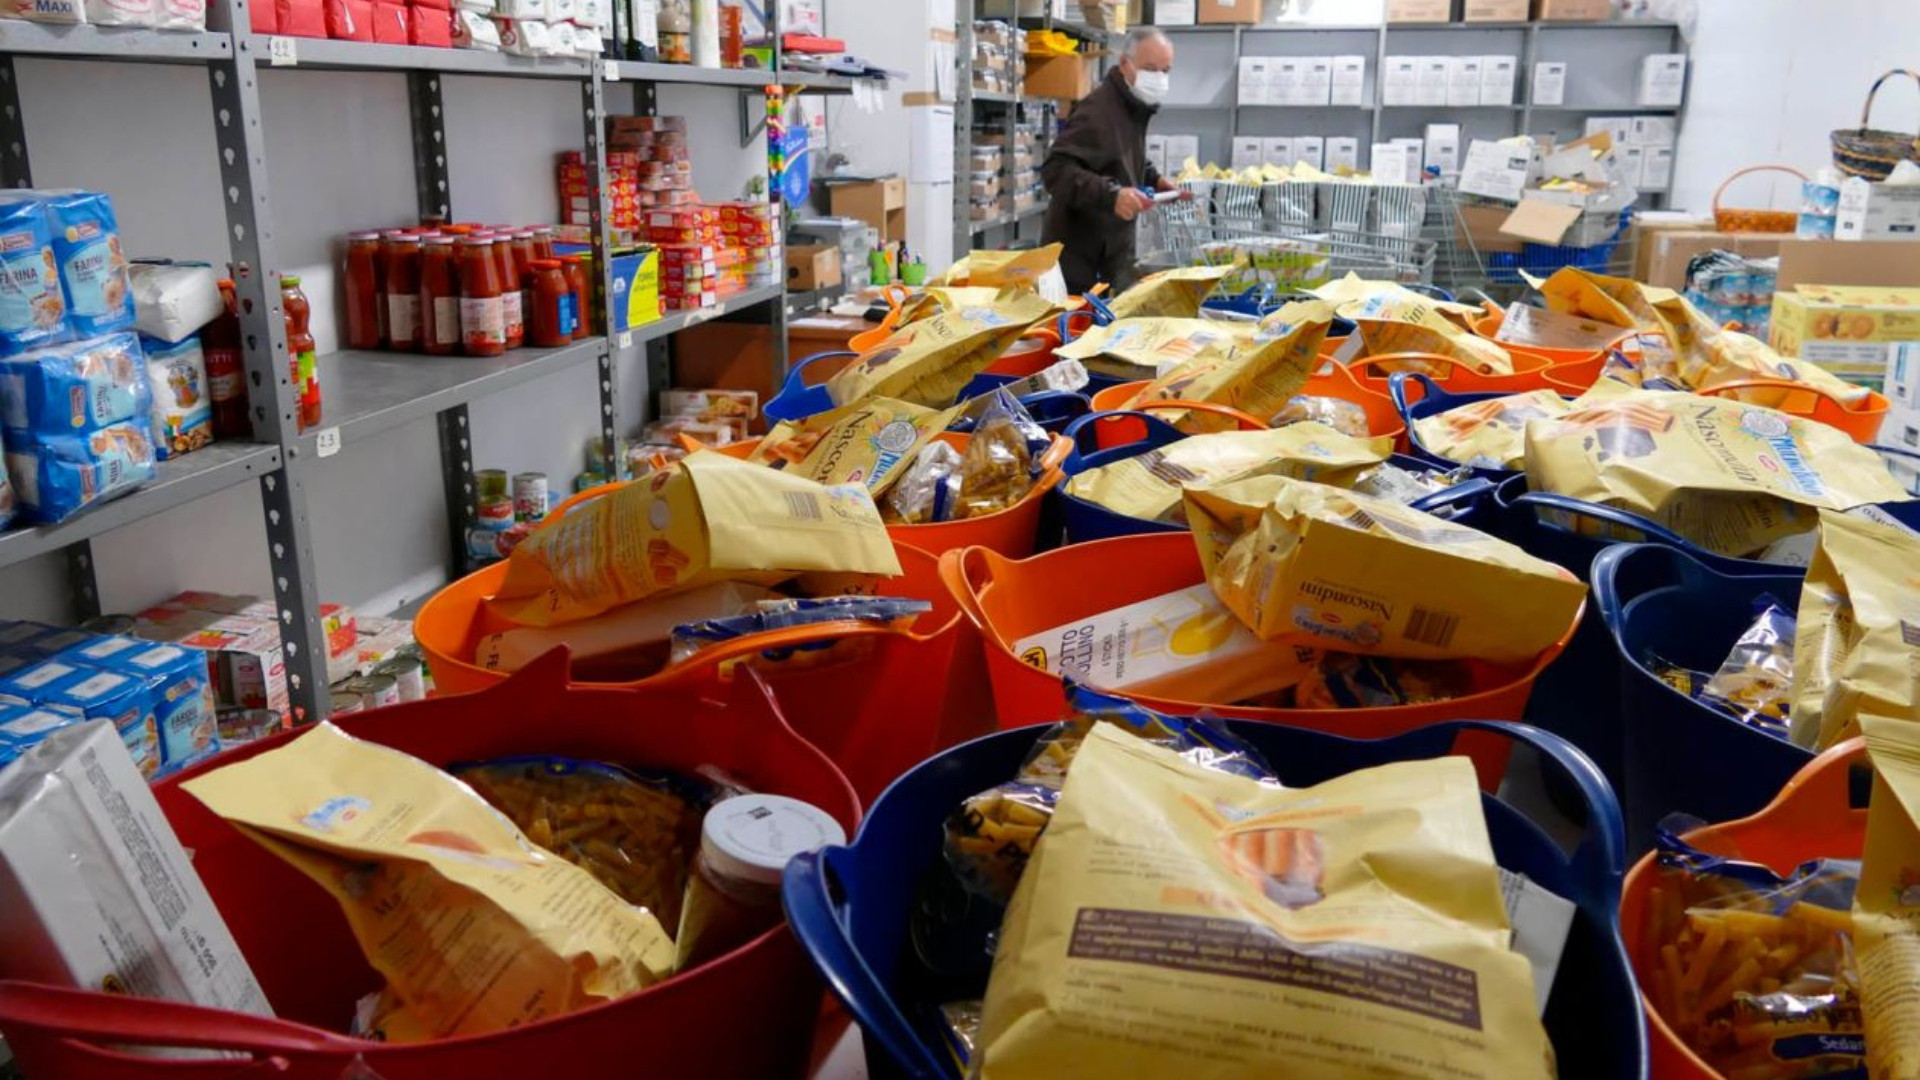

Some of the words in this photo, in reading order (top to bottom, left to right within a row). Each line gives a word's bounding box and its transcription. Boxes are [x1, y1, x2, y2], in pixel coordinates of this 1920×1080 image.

[36, 0, 73, 13] MAXI
[273, 40, 291, 57] 22
[1689, 402, 1760, 487] Nascondini
[1299, 580, 1395, 622] Nascondini
